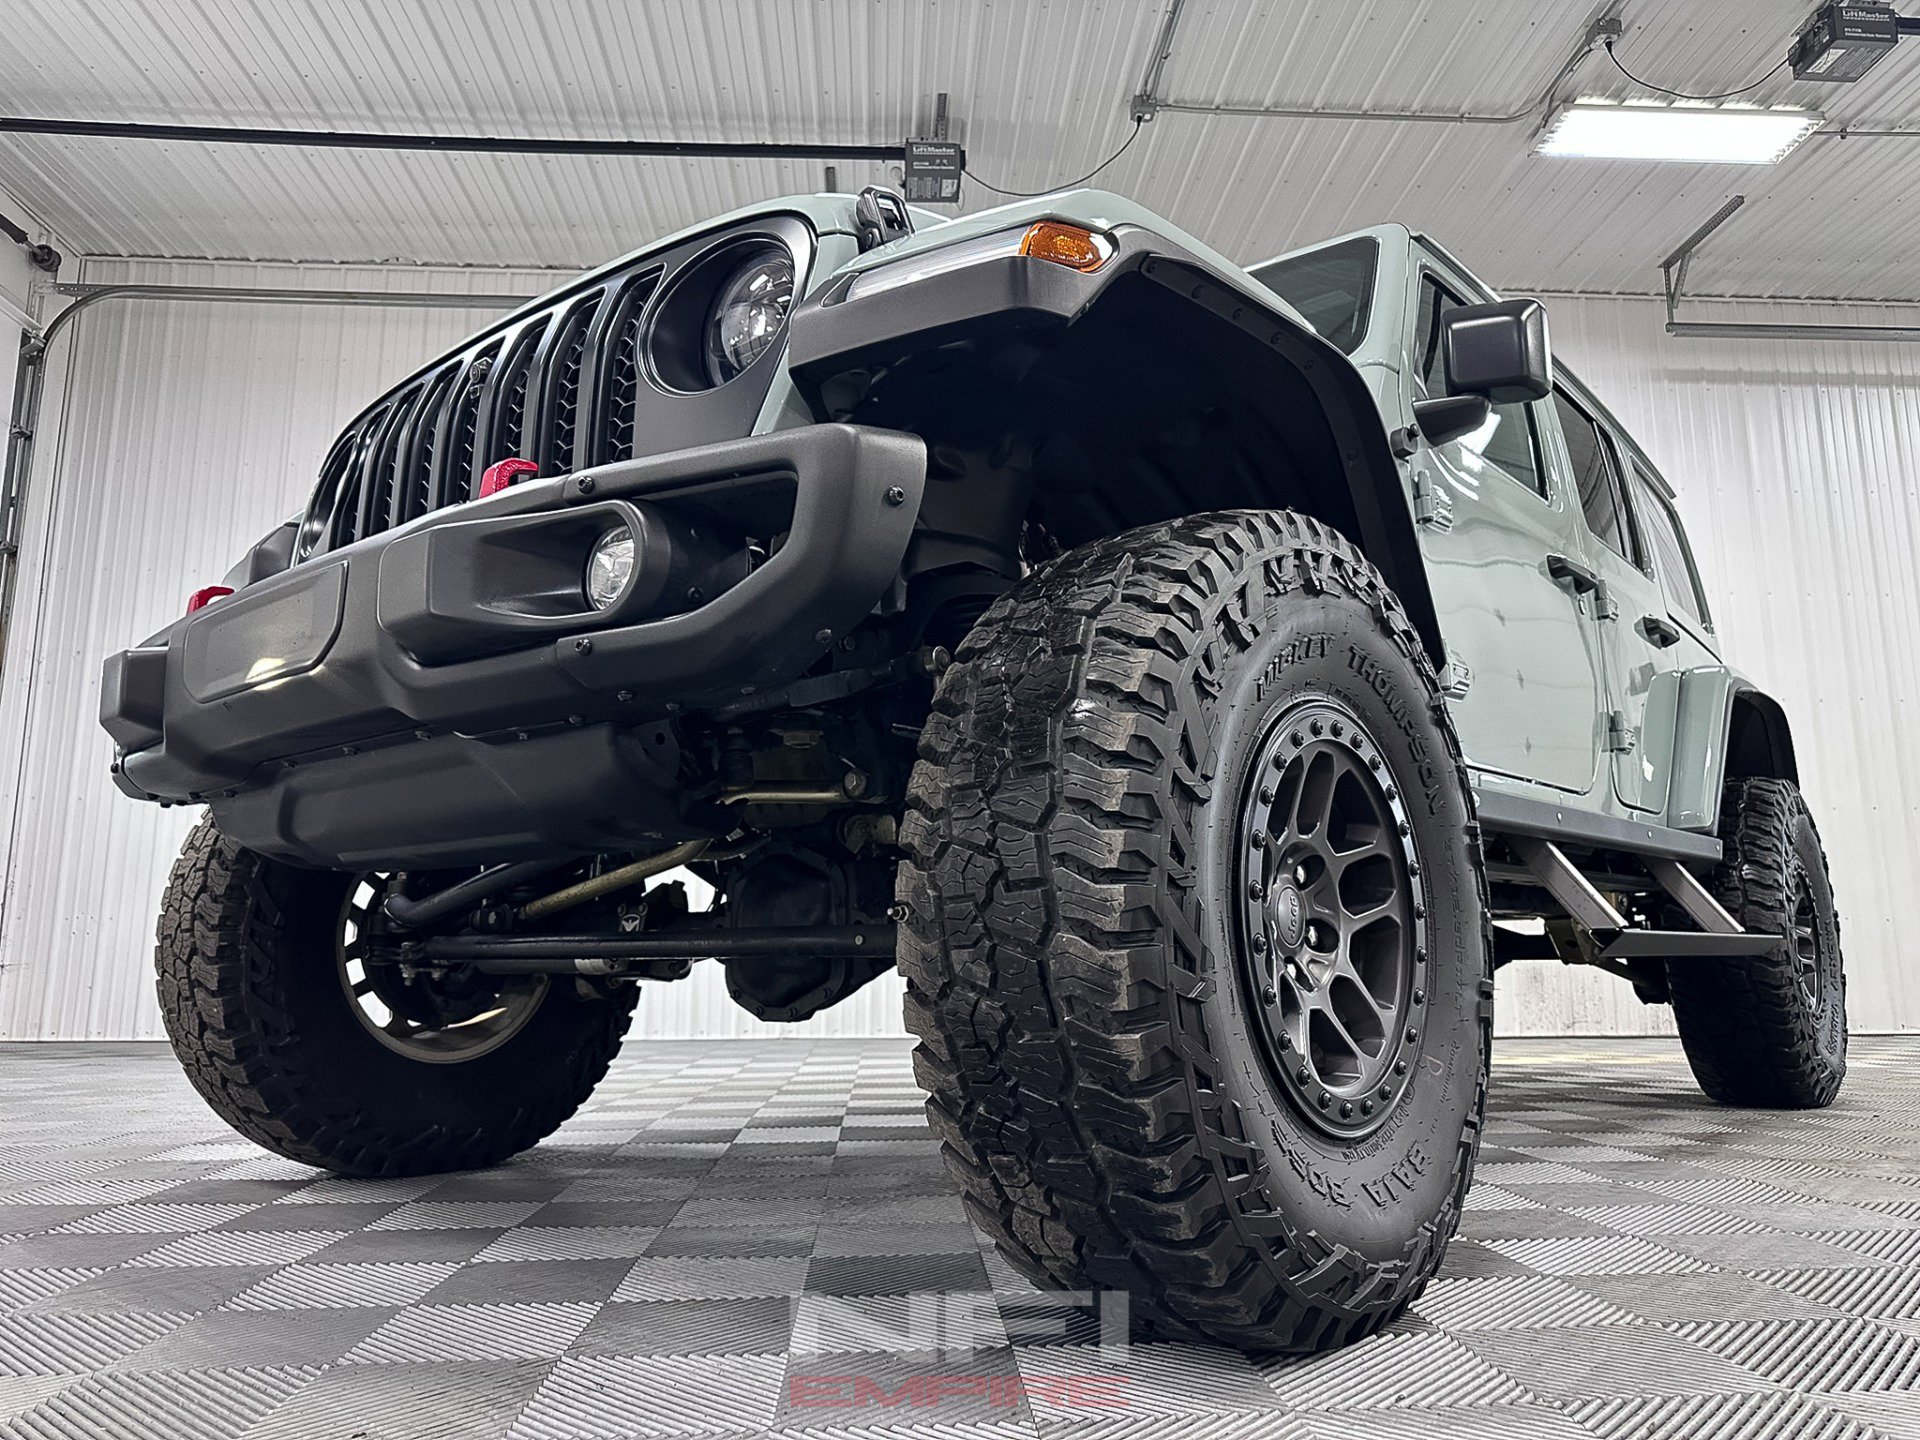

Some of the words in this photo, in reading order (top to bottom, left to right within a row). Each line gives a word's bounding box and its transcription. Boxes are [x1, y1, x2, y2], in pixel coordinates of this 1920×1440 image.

[1843, 10, 1890, 18] LiftMaster
[1348, 643, 1447, 817] THOMPSON
[1362, 1140, 1427, 1207] BAJA
